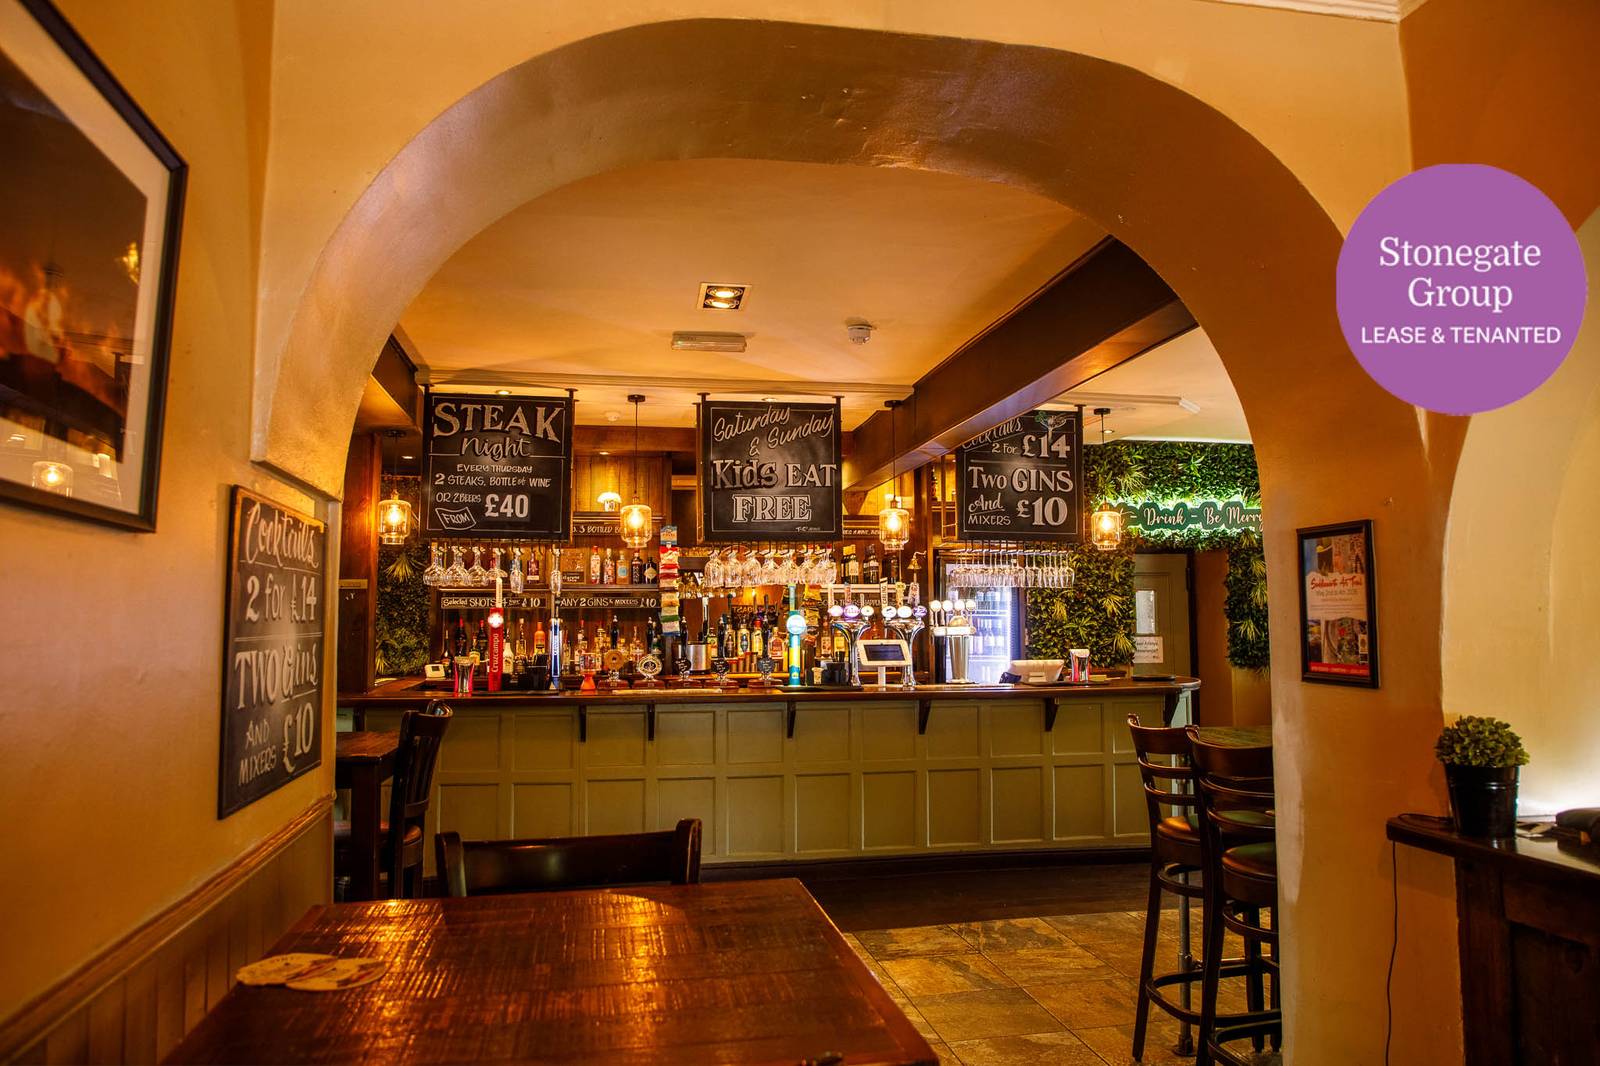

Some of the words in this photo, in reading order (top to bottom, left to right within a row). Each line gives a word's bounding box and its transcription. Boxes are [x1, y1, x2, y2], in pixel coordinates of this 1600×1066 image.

[433, 401, 565, 443] STEAK
[713, 405, 791, 442] Saturday
[749, 437, 760, 457] &
[767, 413, 834, 449] Sunday
[991, 442, 1001, 453] 2
[1022, 434, 1071, 459] £14
[434, 473, 446, 485] 2
[489, 476, 516, 486] BOTTLE
[529, 477, 552, 488] WINE
[456, 463, 489, 472] EVERY
[491, 464, 533, 474] THURSDAY
[713, 459, 778, 489] Kids
[786, 463, 837, 487] EAT
[1011, 468, 1074, 492] GINS
[435, 492, 451, 503] OR
[484, 493, 529, 518] £40
[732, 494, 812, 523] FREE
[1015, 496, 1068, 526] £10
[441, 512, 471, 524] FROM
[967, 514, 1012, 526] MIXERS
[1143, 507, 1186, 526] Drink
[1203, 506, 1222, 525] Be
[246, 501, 319, 569] Cocktails
[246, 575, 260, 622] 2
[265, 573, 286, 620] for
[290, 573, 317, 622] £14
[469, 598, 497, 608] SHOTS
[560, 598, 579, 607] ANY
[580, 597, 587, 607] 2
[587, 597, 609, 607] GINS
[491, 633, 500, 673] Cruzcampo
[235, 649, 280, 710] TWO
[245, 718, 270, 750] AND
[282, 702, 314, 773] £10
[238, 745, 277, 786] MIXERS
